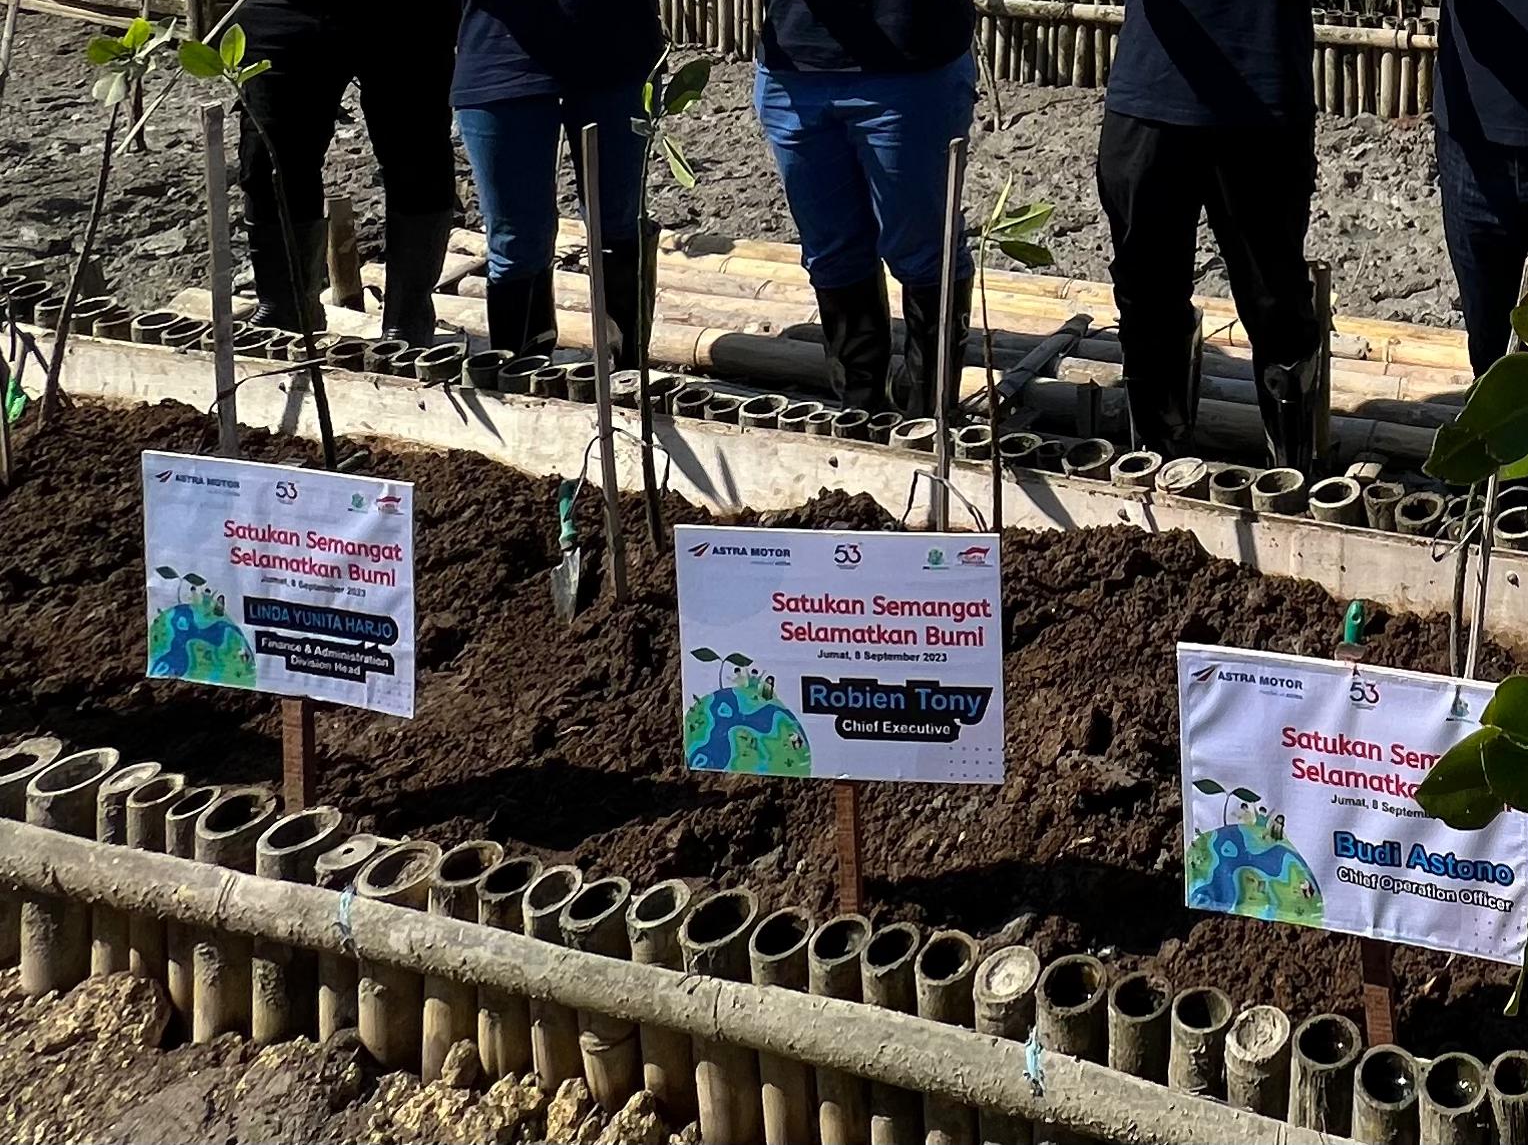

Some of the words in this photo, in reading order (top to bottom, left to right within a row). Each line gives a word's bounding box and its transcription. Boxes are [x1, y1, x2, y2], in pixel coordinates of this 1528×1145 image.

[275, 481, 298, 500] 53
[224, 520, 300, 547] Satukan
[305, 531, 402, 562] Semangat
[712, 546, 748, 556] ASTRA
[751, 547, 790, 558] MOTOR
[834, 544, 862, 564] 53
[230, 547, 341, 579] Selamatkan
[348, 564, 395, 587] Bumi
[772, 592, 864, 615] Satukan
[872, 595, 992, 623] Semangat
[249, 604, 290, 622] LINDA
[292, 610, 342, 631] YUNITA
[345, 617, 393, 639] HARJO
[780, 621, 917, 645] Selamatkan
[926, 626, 984, 647] Bumi
[261, 637, 301, 652] Finance
[304, 644, 312, 654] &
[313, 646, 389, 667] Administration
[290, 655, 332, 670] Division
[334, 662, 361, 675] Head
[817, 650, 851, 661] Jumat,
[864, 651, 920, 663] September
[922, 652, 947, 662] 2023
[1217, 671, 1256, 684] ASTRA
[1259, 675, 1303, 690] MOTOR
[1350, 681, 1380, 704] 53
[809, 684, 905, 710] Robien
[915, 688, 981, 717] Tony
[842, 720, 878, 733] Chief
[882, 721, 951, 735] Executive
[1281, 727, 1383, 762] Satukan
[1331, 794, 1370, 810] Jumat,
[1333, 830, 1402, 867] Budi
[1406, 843, 1515, 887] Astono
[1337, 866, 1378, 890] Chief
[1380, 875, 1457, 903] Operation
[1459, 889, 1514, 913] Officer
